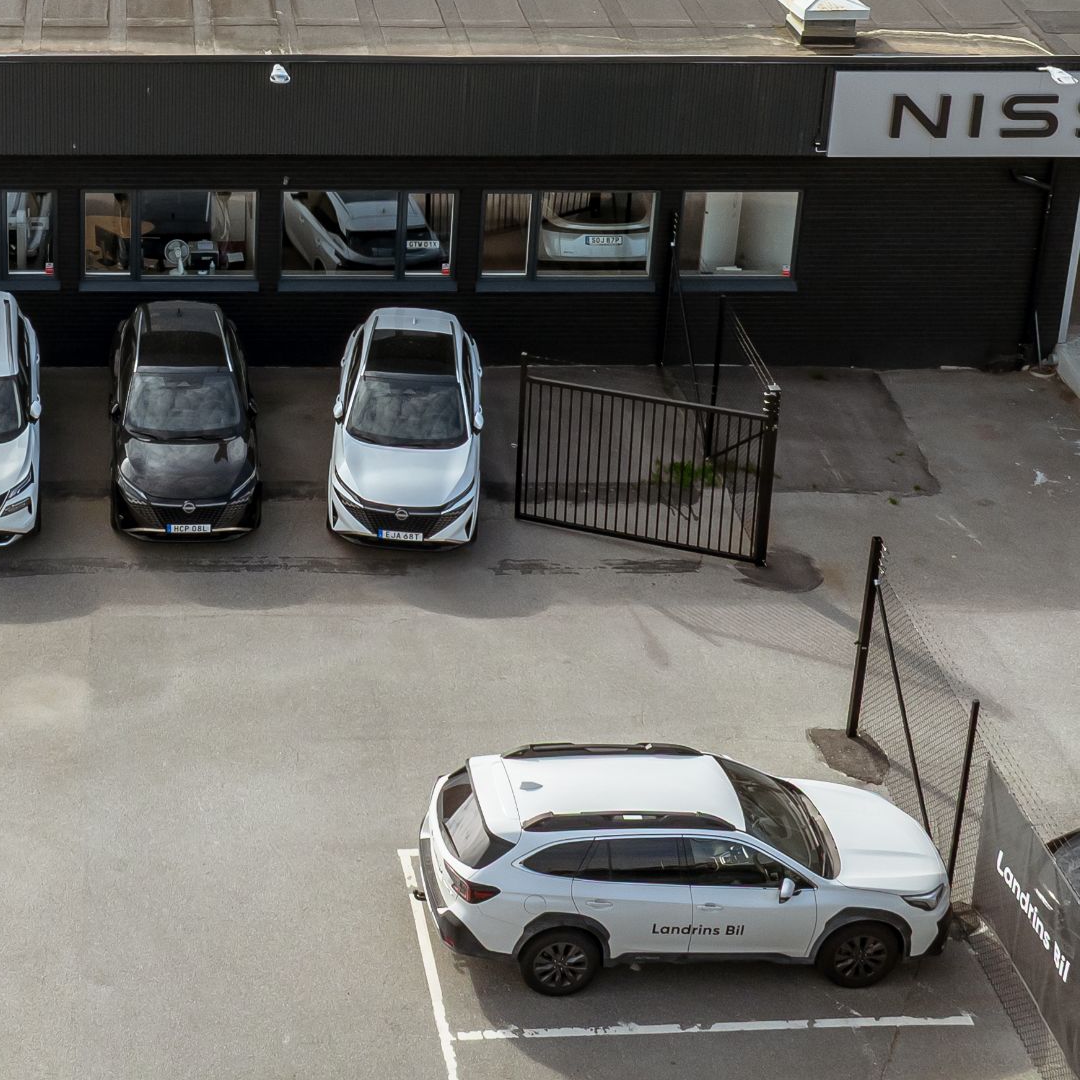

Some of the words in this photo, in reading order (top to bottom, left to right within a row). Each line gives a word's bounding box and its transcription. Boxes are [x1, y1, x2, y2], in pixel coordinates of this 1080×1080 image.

[889, 93, 1080, 139] NIS
[385, 531, 401, 539] EJA
[652, 923, 720, 936] Landrins
[725, 924, 745, 936] Bil
[996, 849, 1051, 950] Landrins
[1053, 940, 1071, 983] Bil
